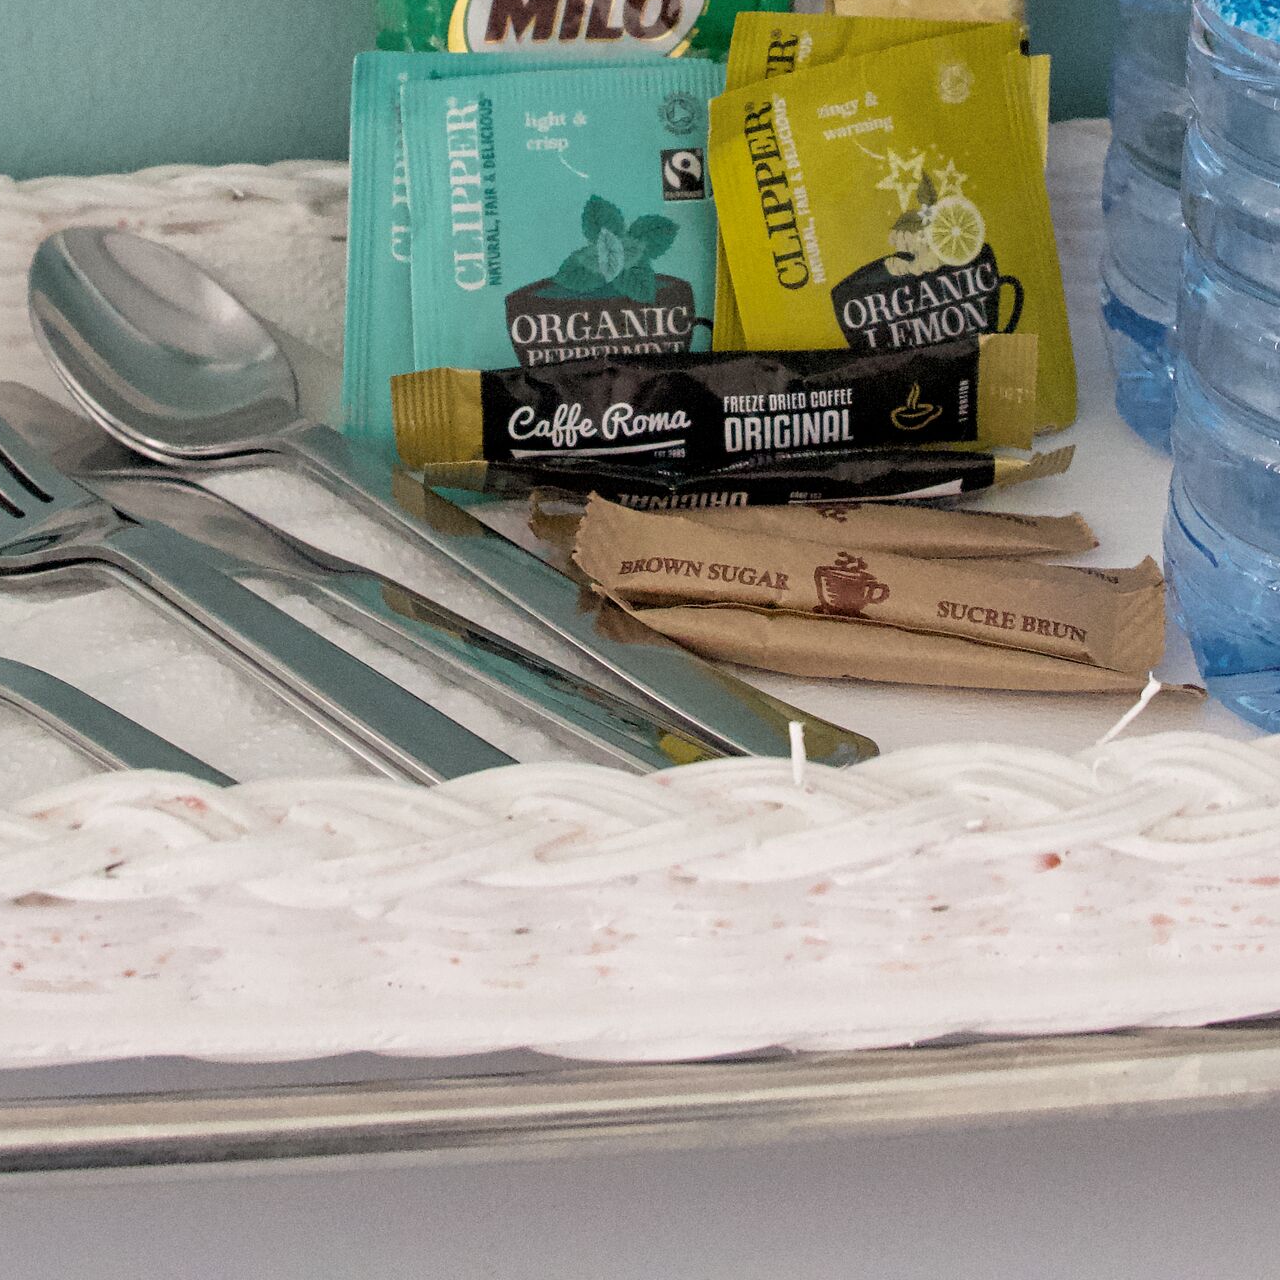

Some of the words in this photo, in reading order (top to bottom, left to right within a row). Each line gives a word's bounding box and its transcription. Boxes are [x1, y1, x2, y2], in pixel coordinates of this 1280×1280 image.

[446, 100, 488, 291] CLIPPER
[744, 102, 810, 290] CLIPPER
[842, 261, 999, 329] ORGANIC
[510, 305, 693, 345] ORGANIC
[723, 394, 765, 413] FREEZE
[768, 392, 806, 412] DRIED
[810, 388, 853, 408] COFFEE
[508, 402, 598, 448] Caffe
[601, 402, 692, 440] Roma
[724, 408, 854, 453] ORIGINAL
[620, 559, 703, 581] BROWN
[705, 562, 790, 592] SUGAR
[936, 600, 1017, 632] SUCRE
[1020, 615, 1088, 644] BRUN
